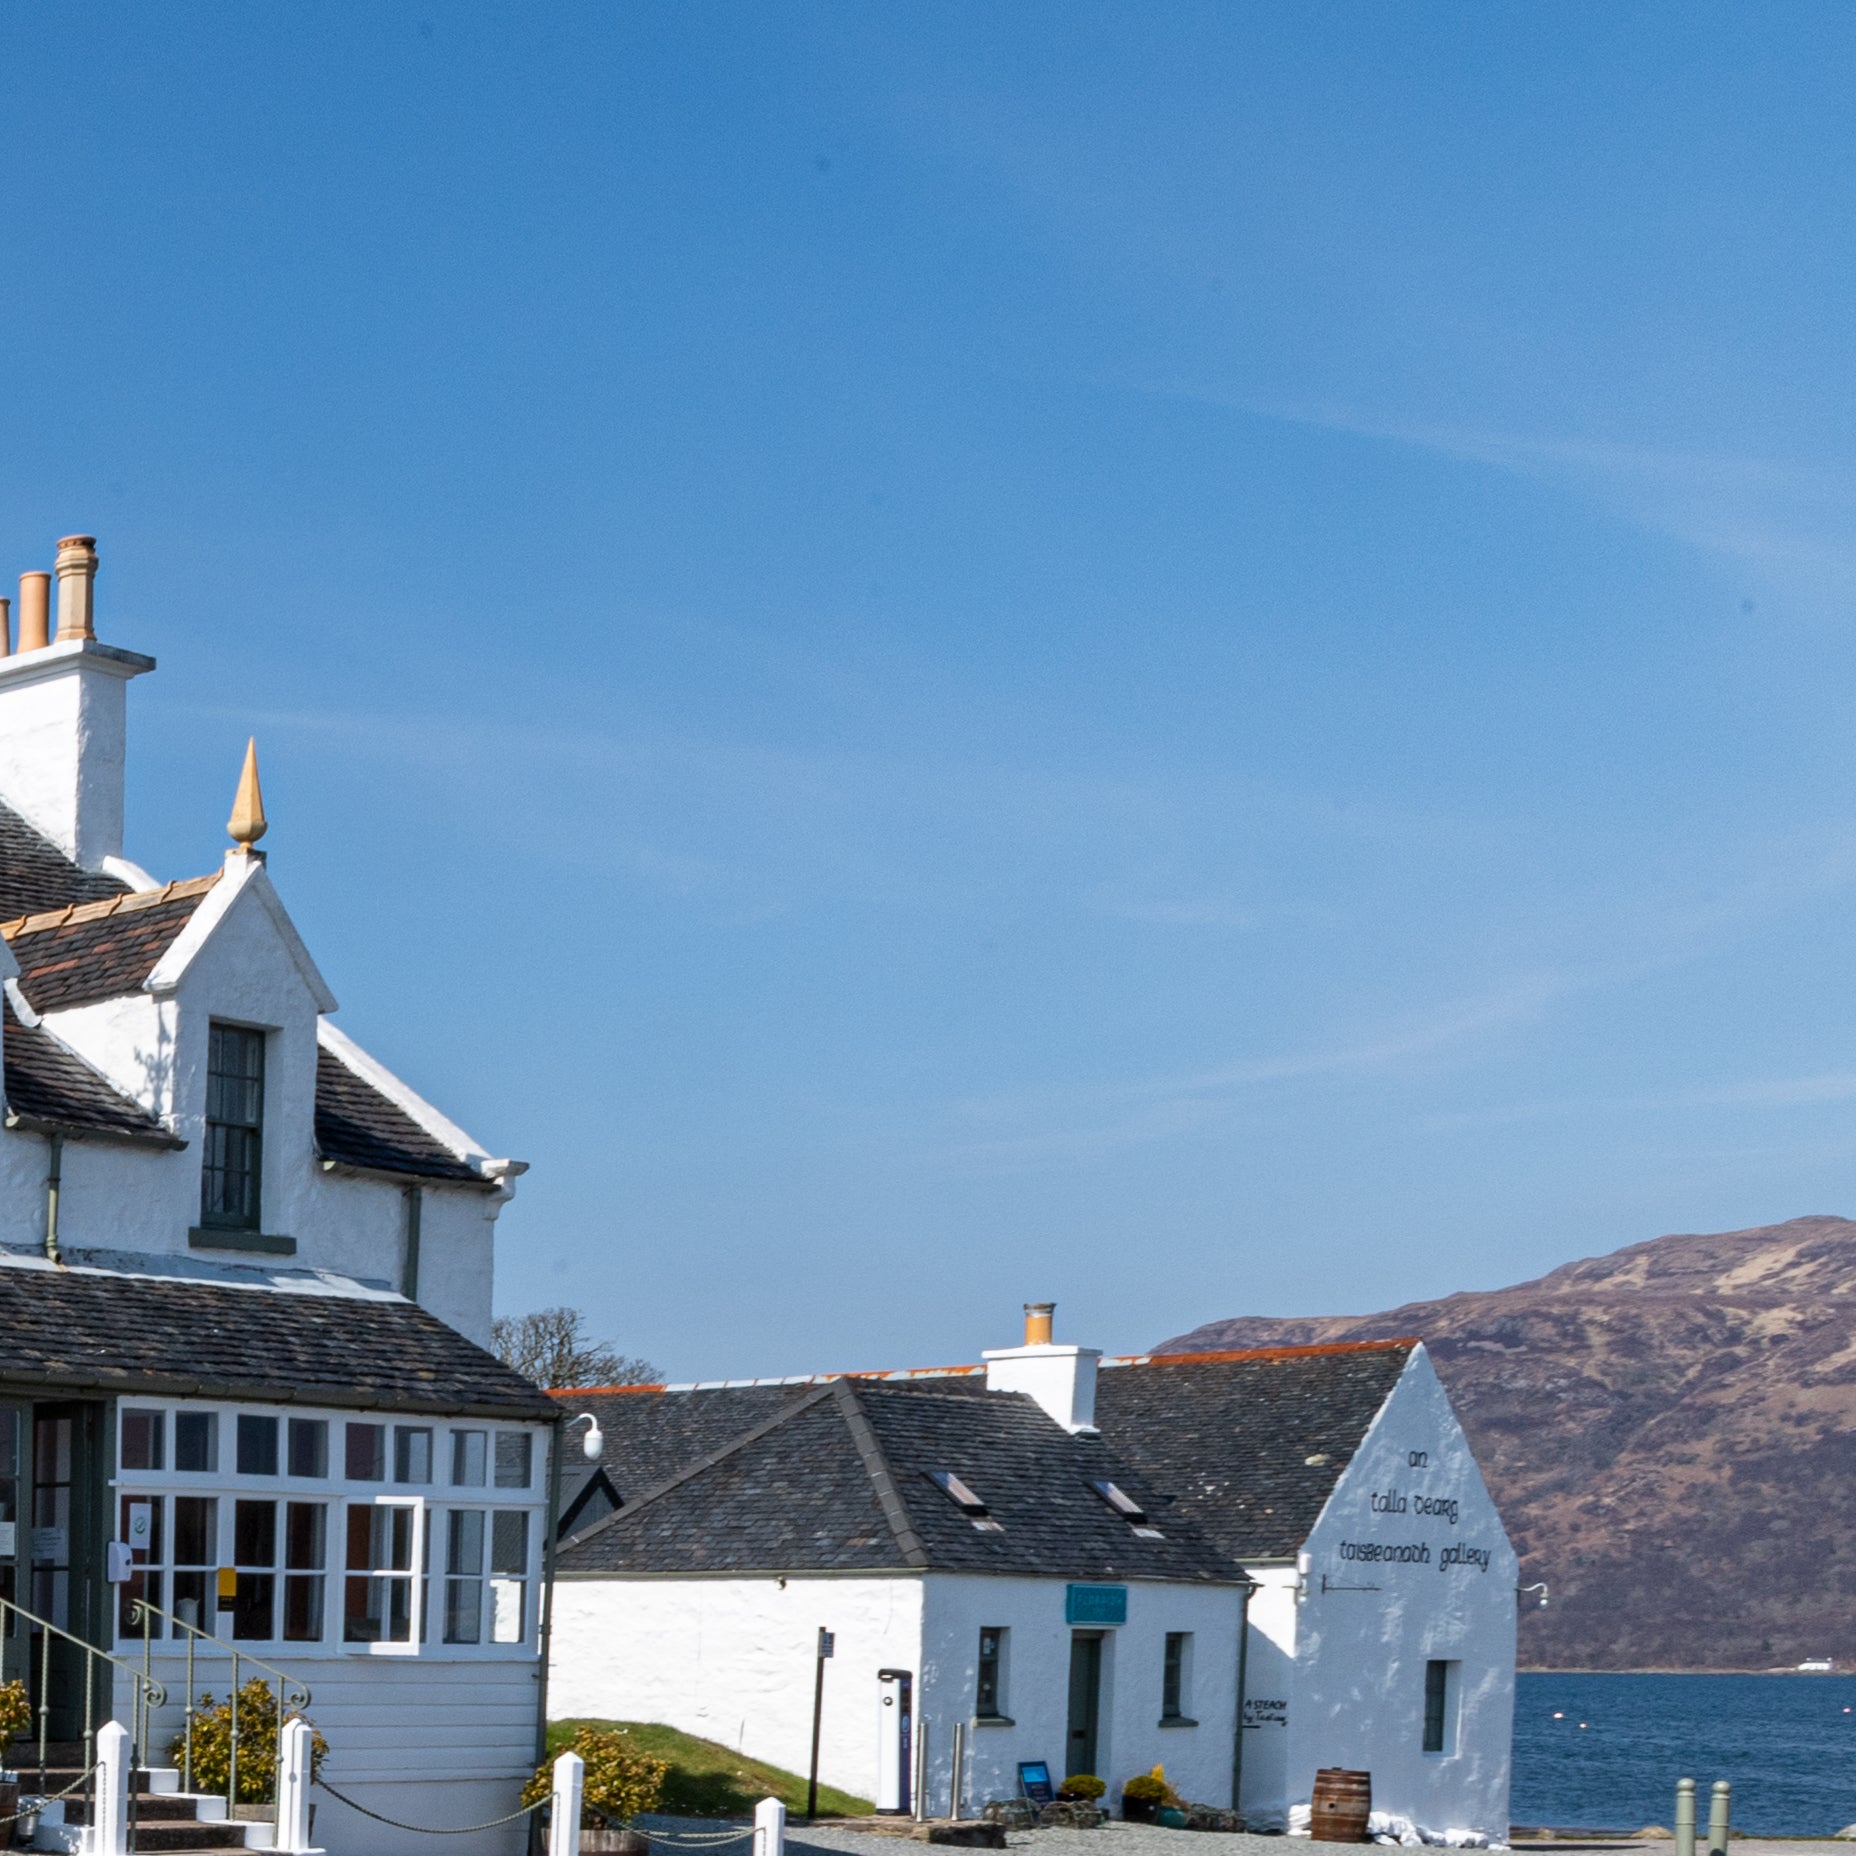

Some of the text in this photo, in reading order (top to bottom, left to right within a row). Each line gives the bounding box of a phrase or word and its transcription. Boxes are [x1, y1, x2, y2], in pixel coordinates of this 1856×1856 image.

[1408, 1450, 1428, 1468] an
[1371, 1489, 1407, 1513] talla
[1253, 1699, 1287, 1710] STEACH
